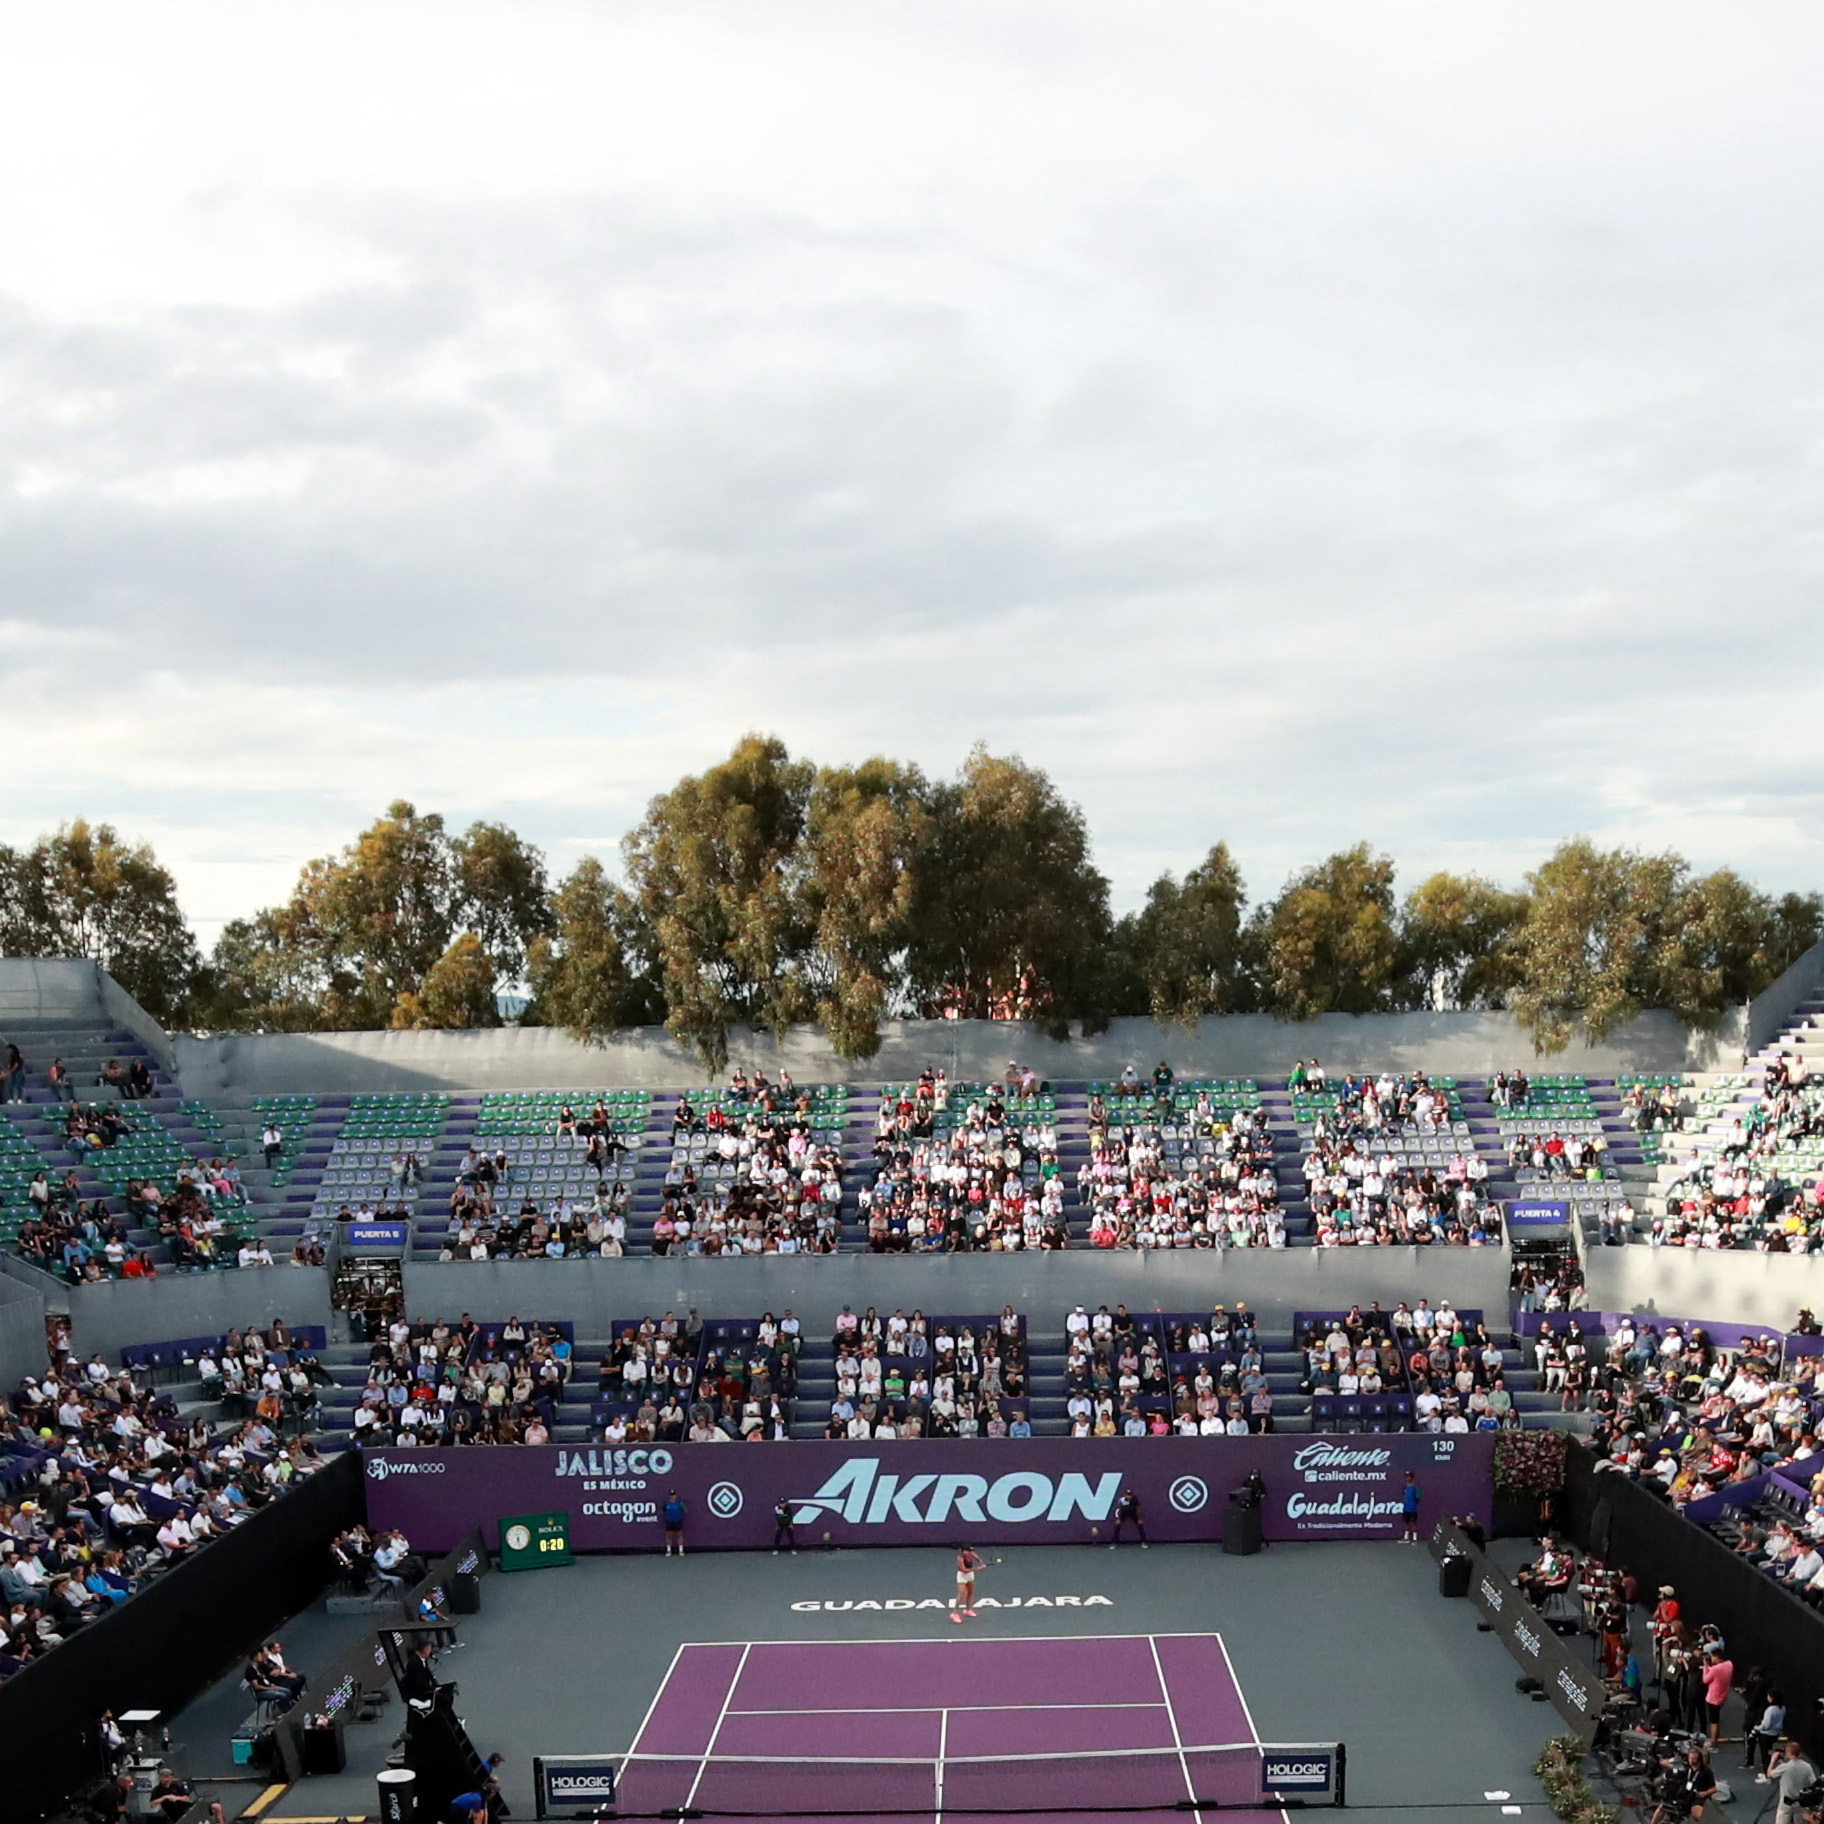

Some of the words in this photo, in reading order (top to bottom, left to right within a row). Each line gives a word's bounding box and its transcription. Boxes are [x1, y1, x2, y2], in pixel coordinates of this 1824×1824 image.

[1514, 1210, 1552, 1218] PUERTA
[1432, 1441, 1454, 1451] 130
[555, 1449, 673, 1476] JALISCO
[1294, 1441, 1391, 1470] Caliente
[1318, 1471, 1386, 1482] caliente.mx
[583, 1481, 597, 1490] ES
[600, 1479, 646, 1490] MÉXICO
[787, 1458, 1122, 1524] AKRON
[582, 1501, 656, 1523] octagon
[1287, 1492, 1404, 1520] Guadalajara
[636, 1515, 658, 1523] event
[539, 1537, 564, 1552] 0:20
[1267, 1762, 1326, 1776] HOLOGIC
[551, 1774, 610, 1789] HOLOGIC
